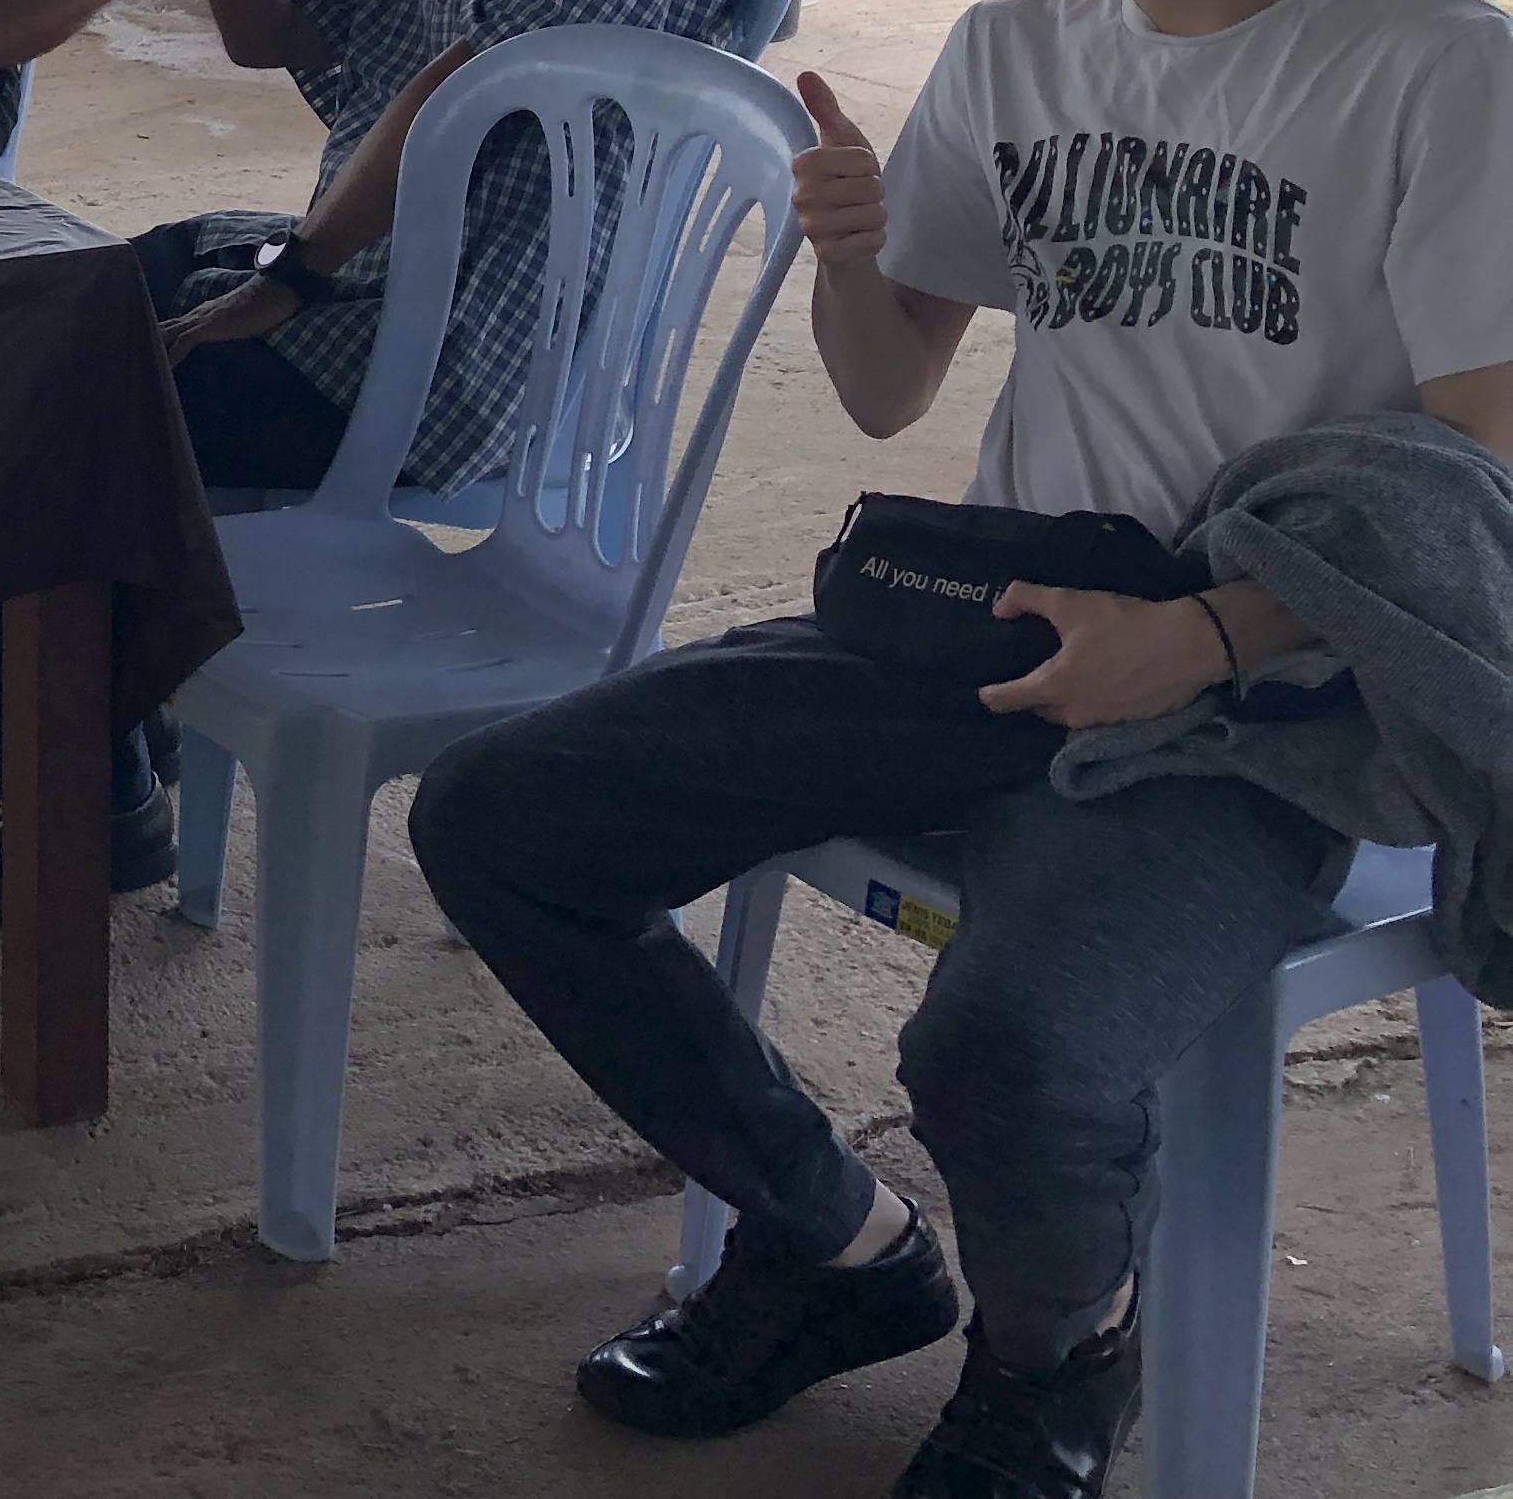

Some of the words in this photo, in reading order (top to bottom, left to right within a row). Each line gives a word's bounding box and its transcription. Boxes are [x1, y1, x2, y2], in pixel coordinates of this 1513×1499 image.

[1048, 241, 1182, 329] BOYS
[1190, 247, 1301, 346] CLUB
[860, 555, 889, 580] All
[889, 567, 929, 592] you
[933, 577, 989, 603] need
